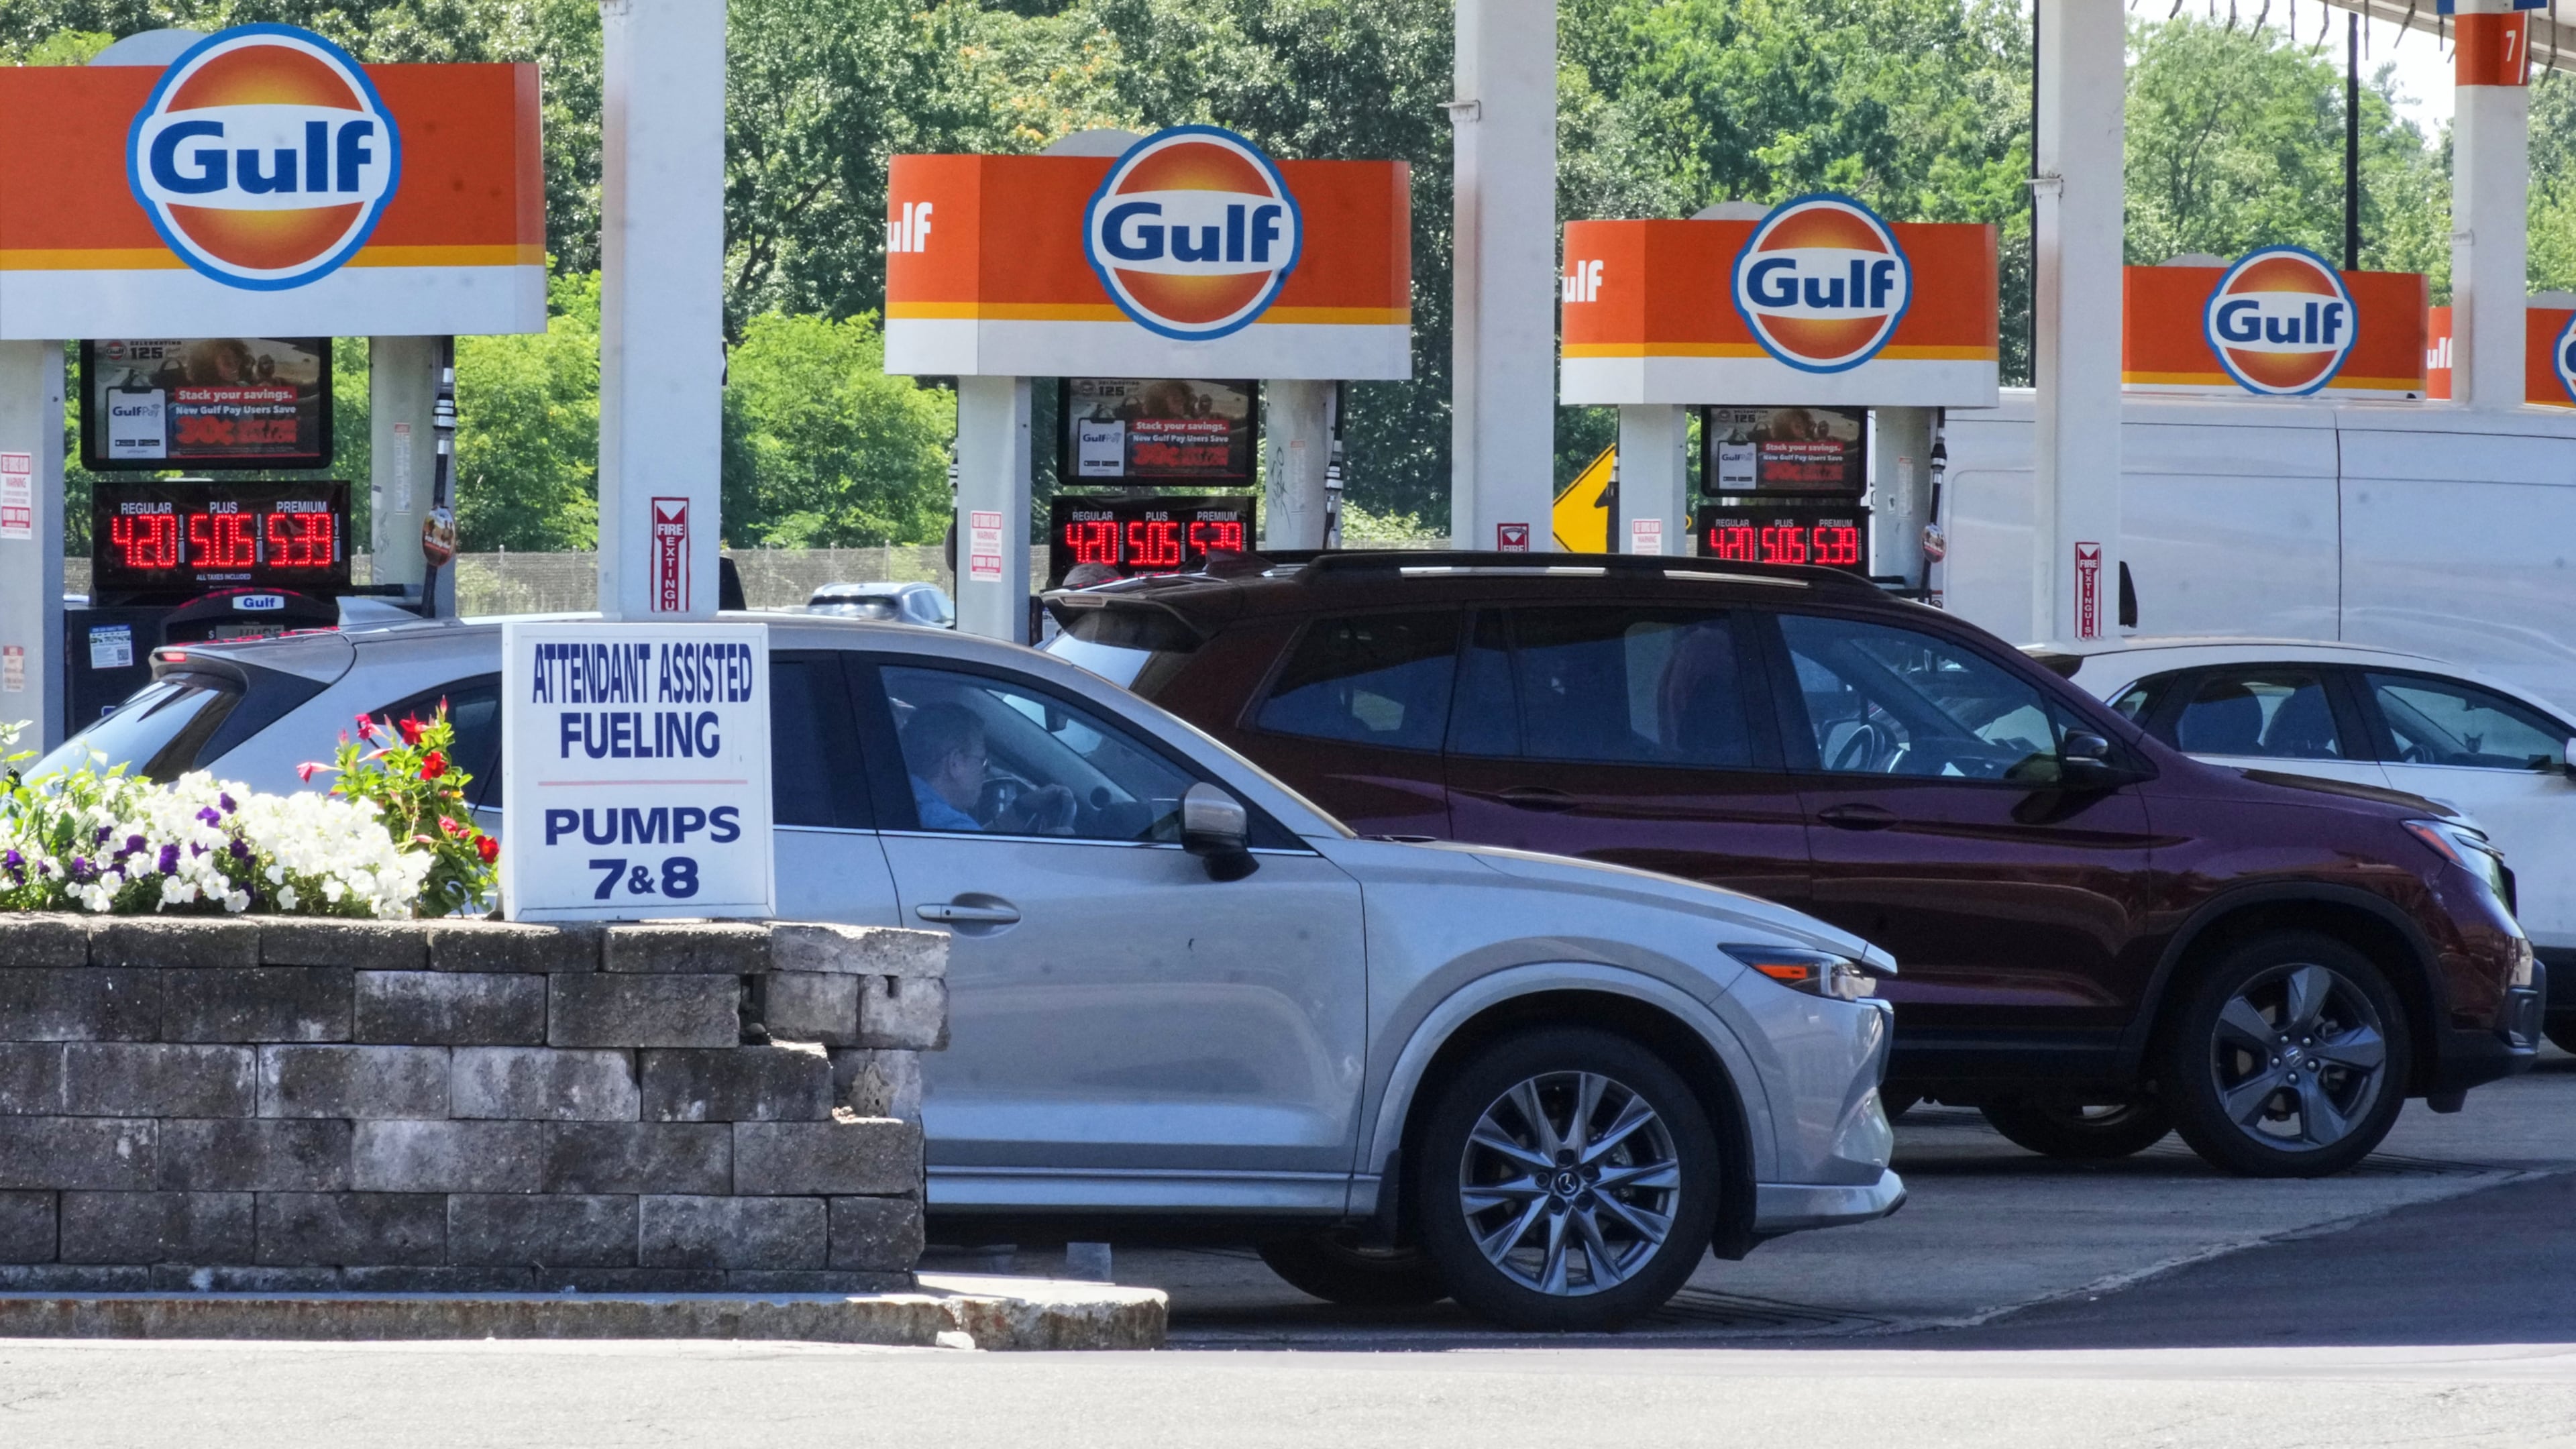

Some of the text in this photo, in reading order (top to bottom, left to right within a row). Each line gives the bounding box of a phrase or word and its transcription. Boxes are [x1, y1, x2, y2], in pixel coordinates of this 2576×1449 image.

[2506, 30, 2516, 62] 7
[150, 120, 374, 195] Gulf
[887, 201, 933, 253] ulf
[1102, 201, 1282, 262] Gulf
[1562, 260, 1603, 303] ulf
[1746, 258, 1896, 309] Gulf
[2216, 299, 2343, 345] Gulf
[130, 347, 163, 360] 125
[179, 389, 292, 402] Stack your savings.
[1098, 386, 1125, 396] 125
[201, 405, 221, 414] Gulf
[223, 406, 241, 416] Pay
[244, 406, 270, 414] Users
[273, 405, 297, 413] Save
[1735, 415, 1756, 423] 125
[1164, 423, 1185, 432] your
[1187, 421, 1226, 432] savings.
[1171, 435, 1185, 443] Pay
[1809, 443, 1841, 452] savings.
[121, 501, 327, 515] REGULAR PLUS PREMIUM
[1072, 511, 1238, 521] REGULAR PLUS PREMIUM
[657, 523, 684, 535] FIRE
[1715, 519, 1853, 527] REGULAR PLUS PREMIUM
[112, 515, 177, 568] 4.20
[189, 513, 256, 568] 5.05
[267, 513, 333, 567] 5.39
[1128, 521, 1180, 566] 5.05
[1189, 521, 1242, 555] 539
[1710, 527, 1858, 565] 420 5.05 5.39
[664, 537, 676, 611] EXTINGU
[2080, 559, 2097, 568] FIRE
[244, 597, 275, 608] Gulf
[208, 629, 215, 639] $
[533, 643, 752, 704] ATTENDANT ASSISTED
[561, 711, 720, 759] FUELING
[545, 806, 741, 845] PUMPS
[589, 857, 699, 900] 7&8
